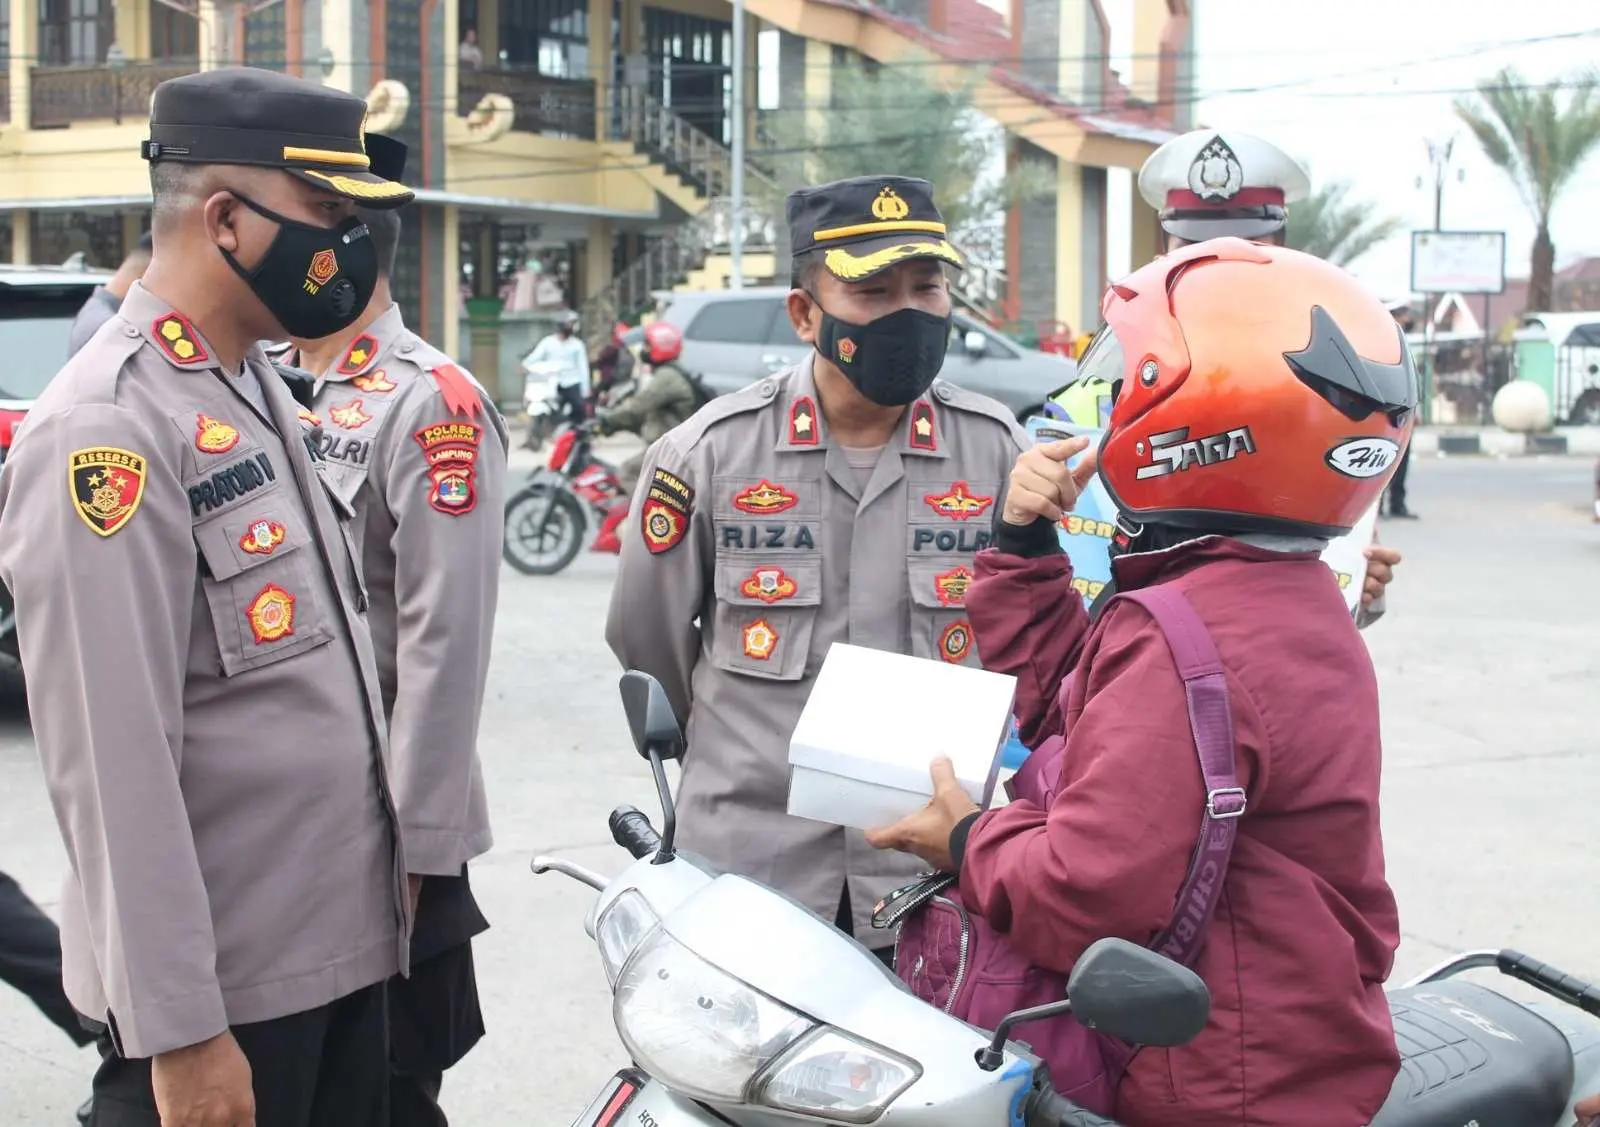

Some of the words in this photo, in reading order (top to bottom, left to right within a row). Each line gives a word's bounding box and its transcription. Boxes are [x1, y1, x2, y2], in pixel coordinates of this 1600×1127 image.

[302, 279, 320, 295] TNI
[424, 424, 474, 440] POLRES
[317, 433, 369, 464] OLRI
[430, 449, 473, 462] LAMPUNG
[1136, 425, 1257, 480] SAGA
[1347, 447, 1389, 468] Hiu
[78, 452, 138, 469] RESERSE
[721, 525, 814, 549] RIZA
[913, 529, 992, 552] POLR
[1160, 861, 1218, 957] CHIBA
